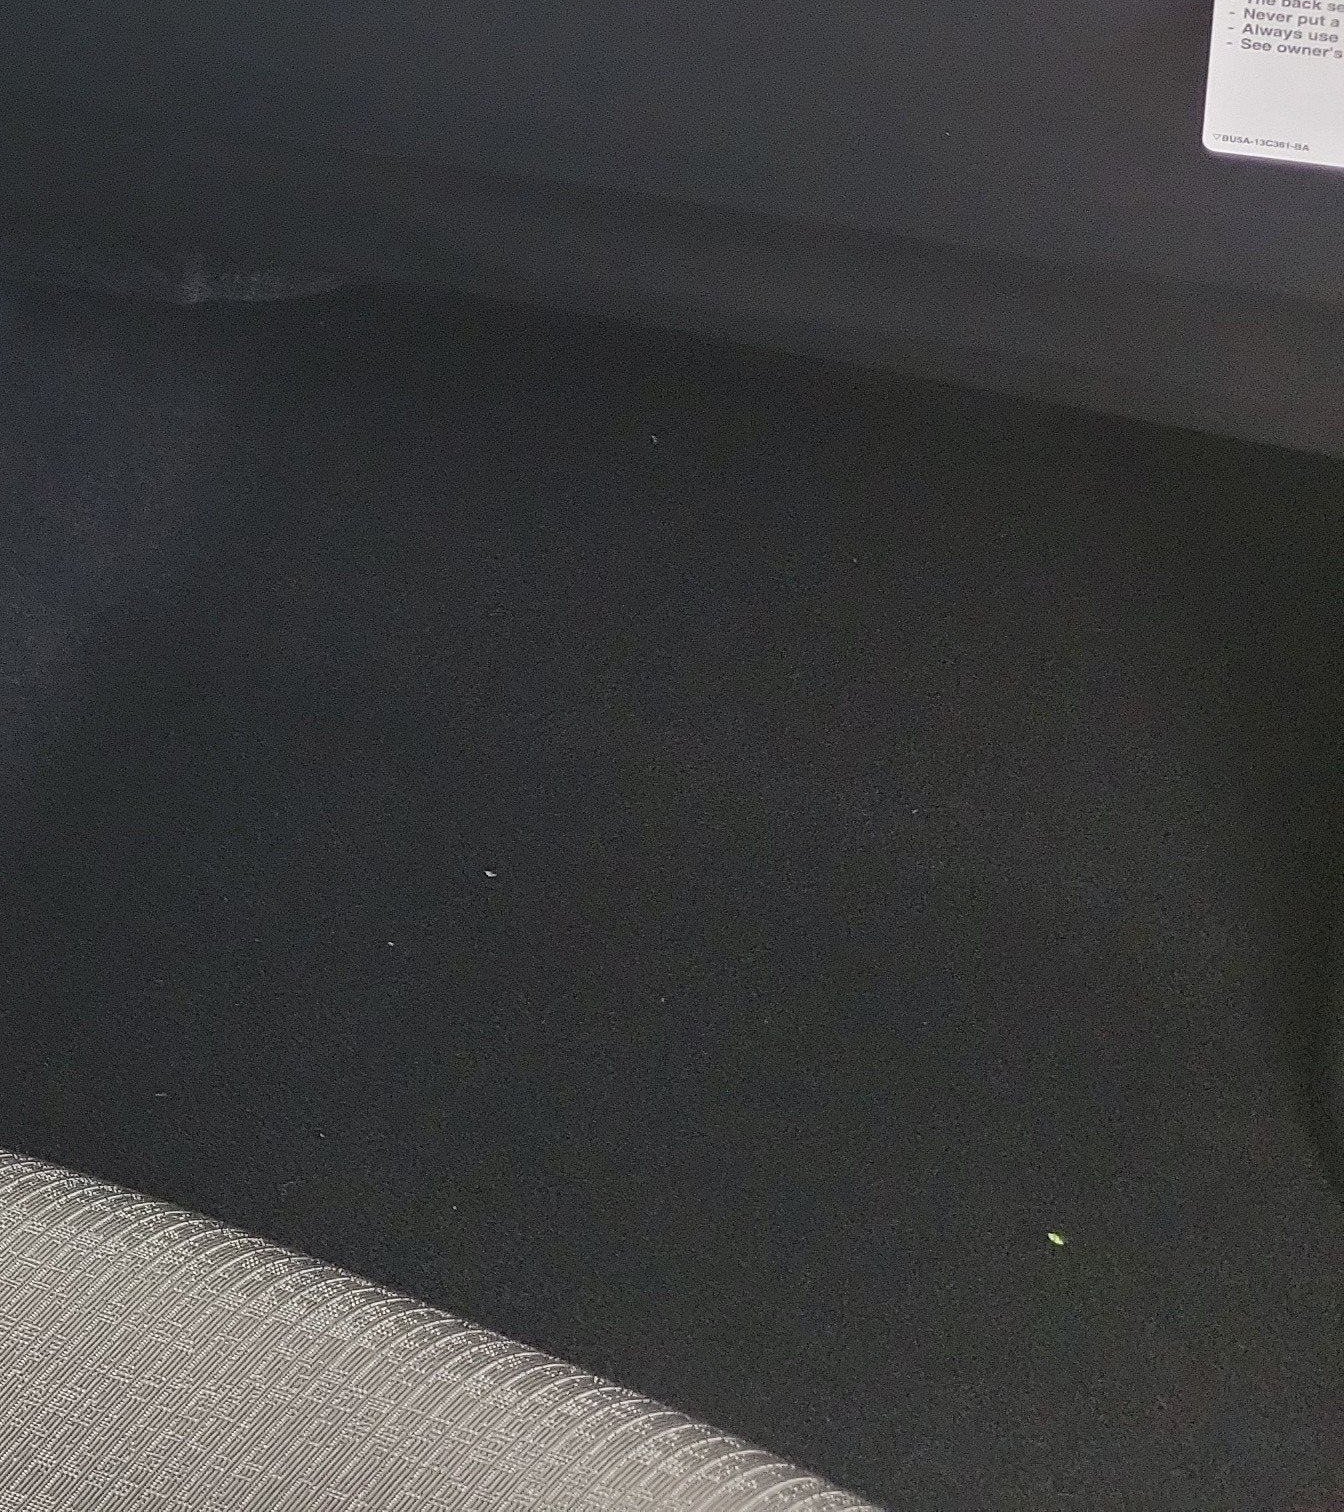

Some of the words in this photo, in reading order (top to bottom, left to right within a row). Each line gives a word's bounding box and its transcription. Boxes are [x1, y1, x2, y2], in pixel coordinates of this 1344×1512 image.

[1243, 8, 1293, 23] Never
[1297, 15, 1326, 27] put
[1330, 18, 1340, 28] a
[1242, 23, 1303, 40] Always
[1308, 32, 1339, 43] use
[1240, 38, 1272, 52] See
[1276, 44, 1343, 59] owner's
